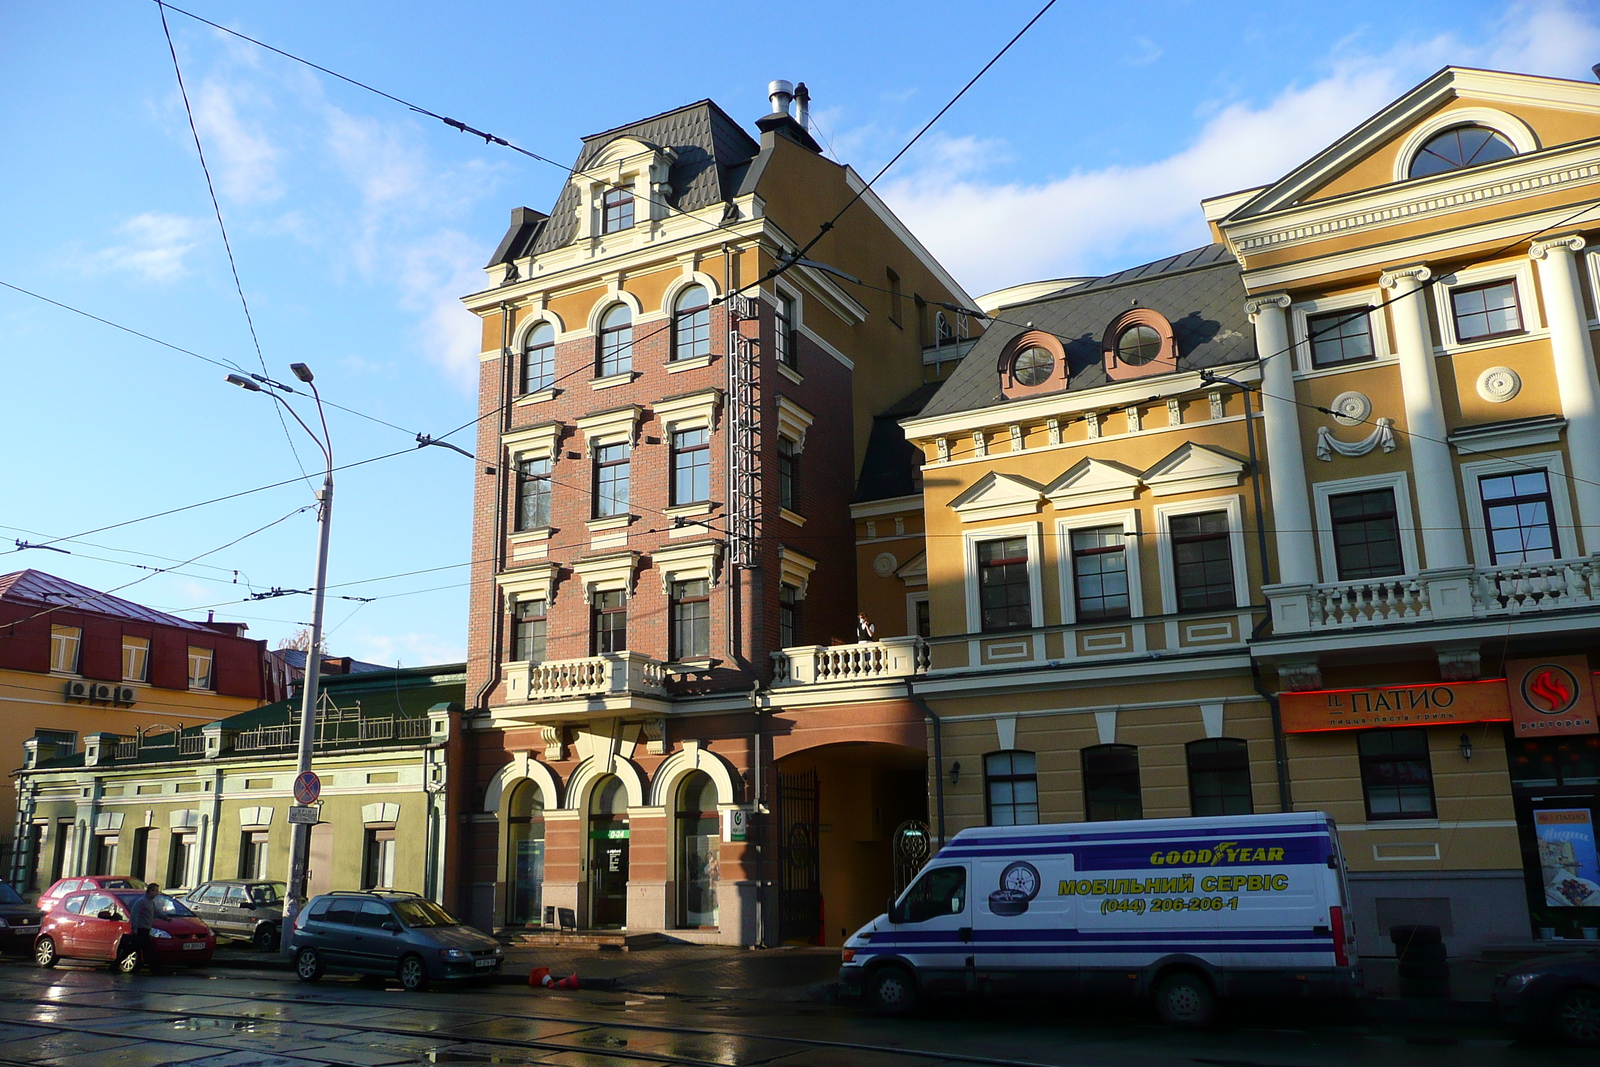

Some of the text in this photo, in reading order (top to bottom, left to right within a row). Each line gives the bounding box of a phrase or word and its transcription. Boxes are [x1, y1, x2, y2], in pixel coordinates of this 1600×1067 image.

[1350, 686, 1454, 713] ПАТИО
[1374, 715, 1409, 723] паста
[1417, 712, 1454, 721] гриль
[1521, 719, 1591, 731] ресторан
[1058, 873, 1289, 896] МОБІЛЬНИЙ СЕРВІС
[1101, 896, 1239, 915] (044) 206-206-1
